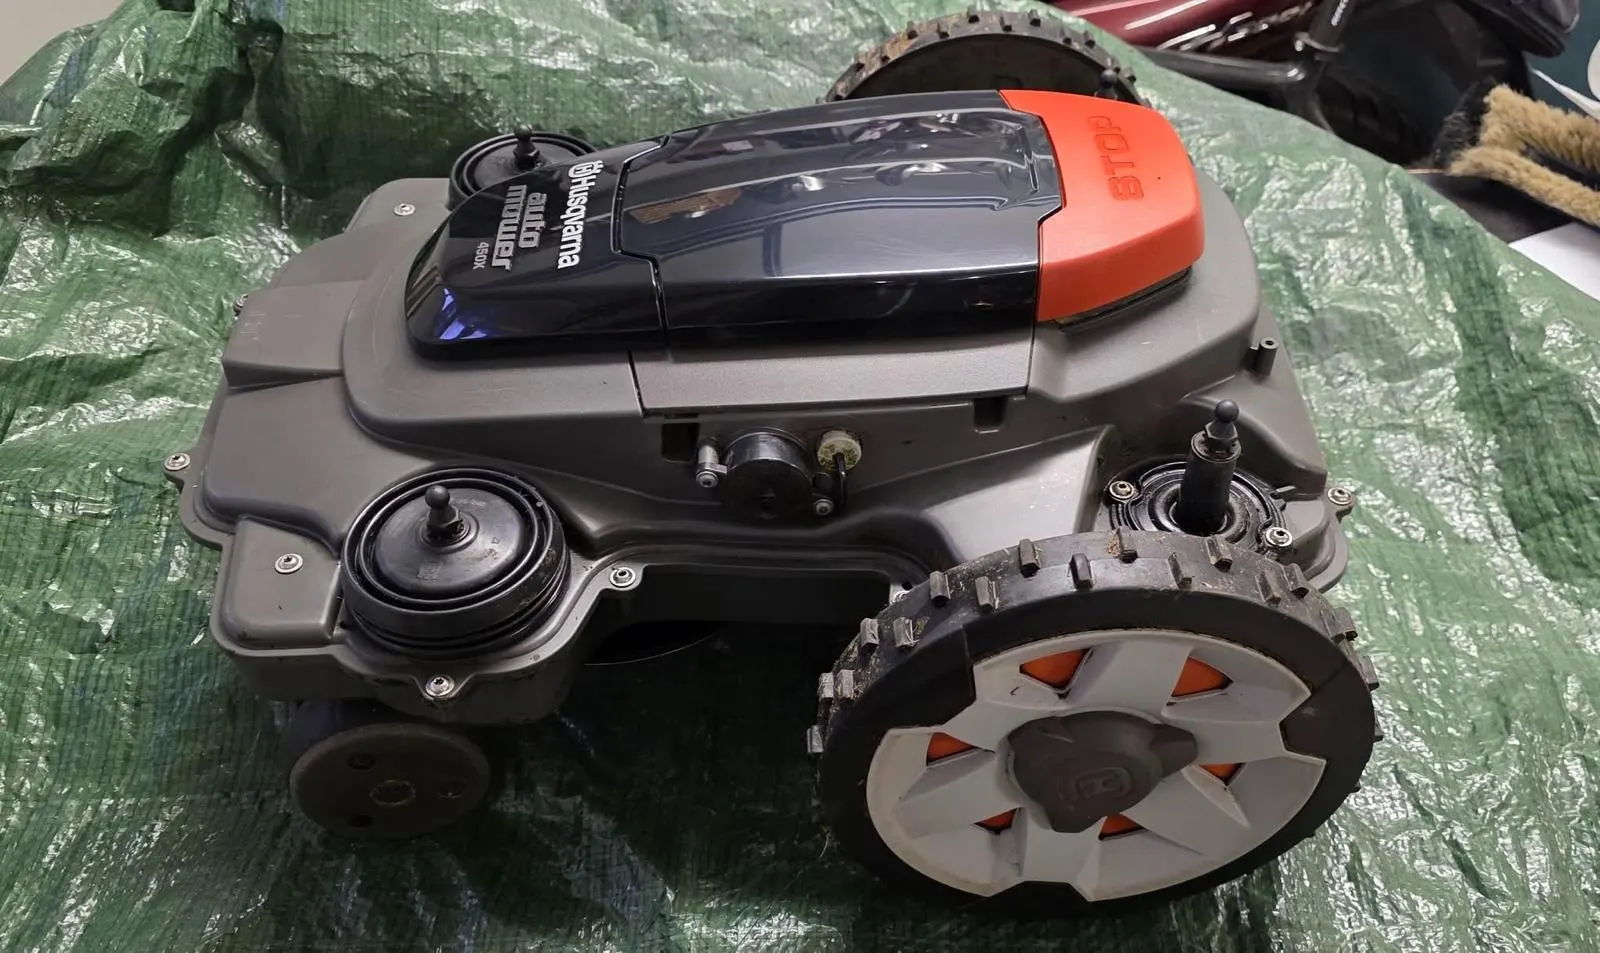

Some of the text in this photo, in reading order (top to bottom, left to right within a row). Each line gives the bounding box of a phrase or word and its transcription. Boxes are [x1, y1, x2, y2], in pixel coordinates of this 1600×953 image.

[1087, 116, 1144, 200] STOP
[472, 241, 490, 270] 450X
[492, 184, 527, 271] mower
[518, 192, 547, 249] auto
[558, 174, 597, 269] Husqvarna
